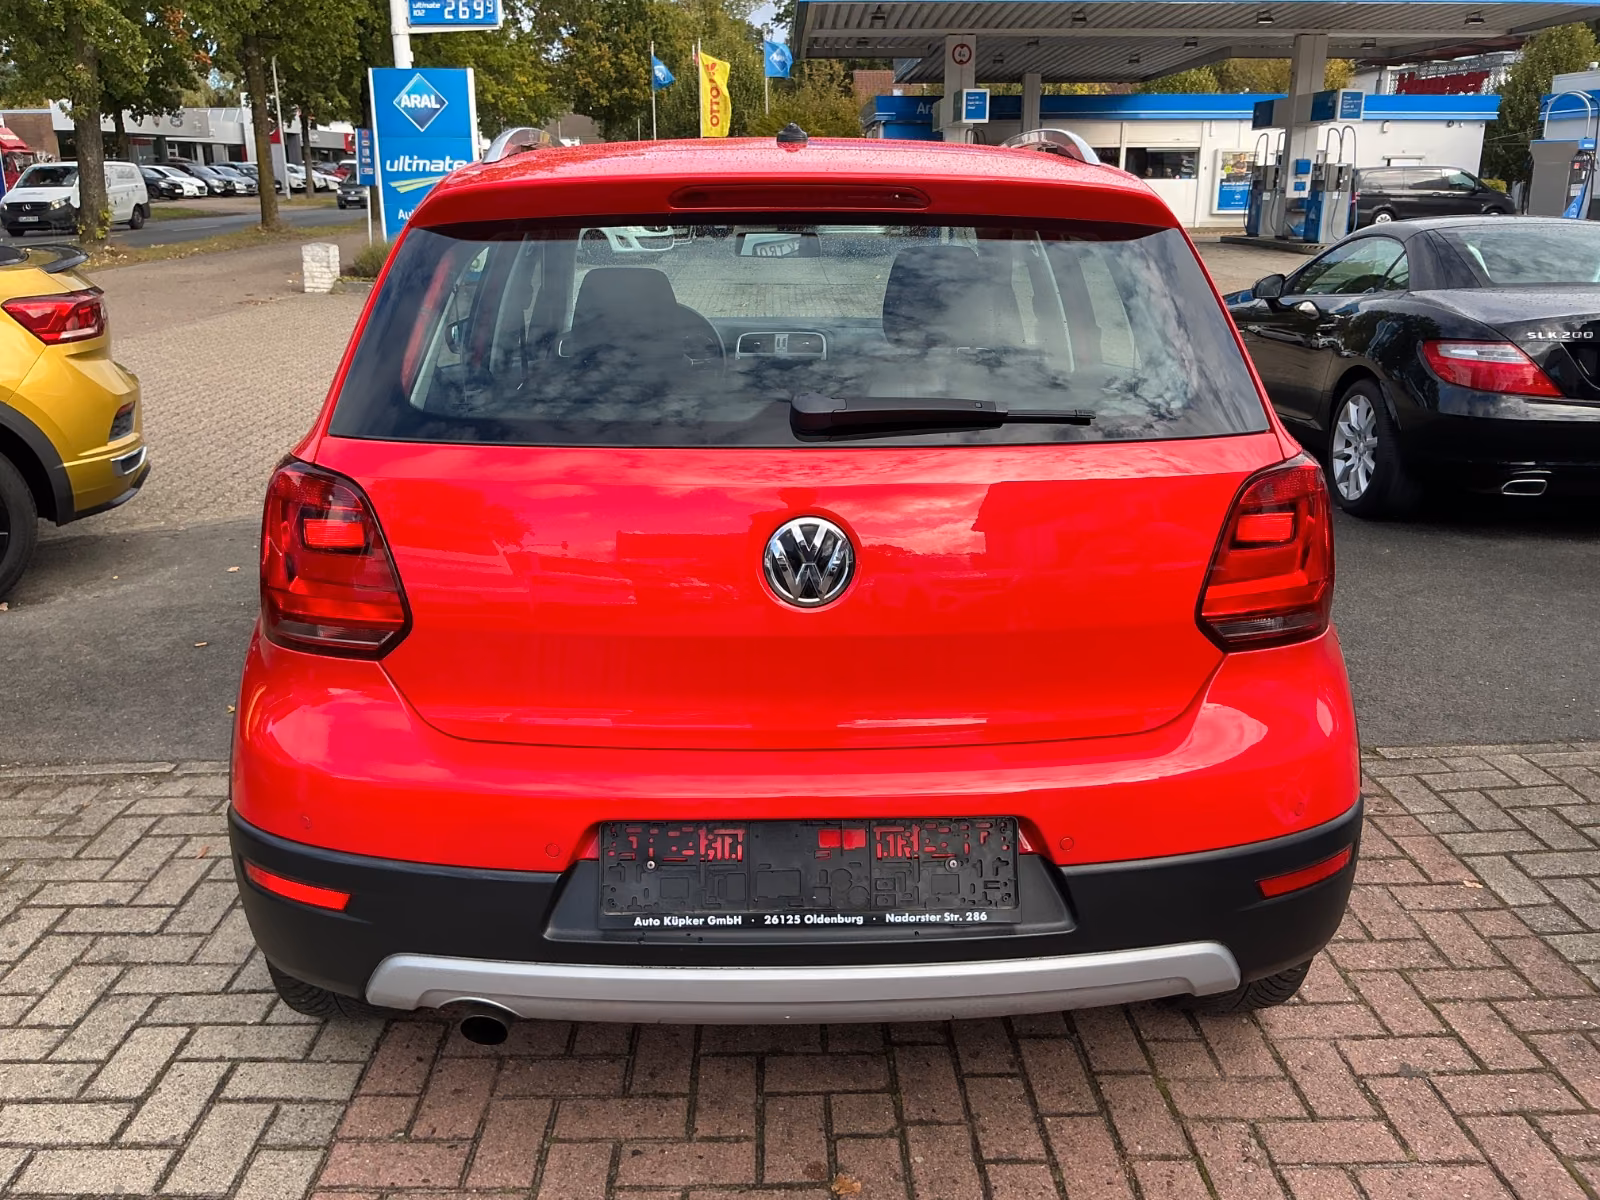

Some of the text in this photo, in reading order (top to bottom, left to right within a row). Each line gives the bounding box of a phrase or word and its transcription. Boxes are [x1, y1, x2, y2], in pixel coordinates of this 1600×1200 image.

[400, 94, 441, 109] ARAL
[385, 155, 468, 172] ultimate
[1527, 331, 1594, 340] SLK 200
[633, 911, 988, 928] Auto Küpker GmbH 26125 Oldenburg Nadorster Str. 286
